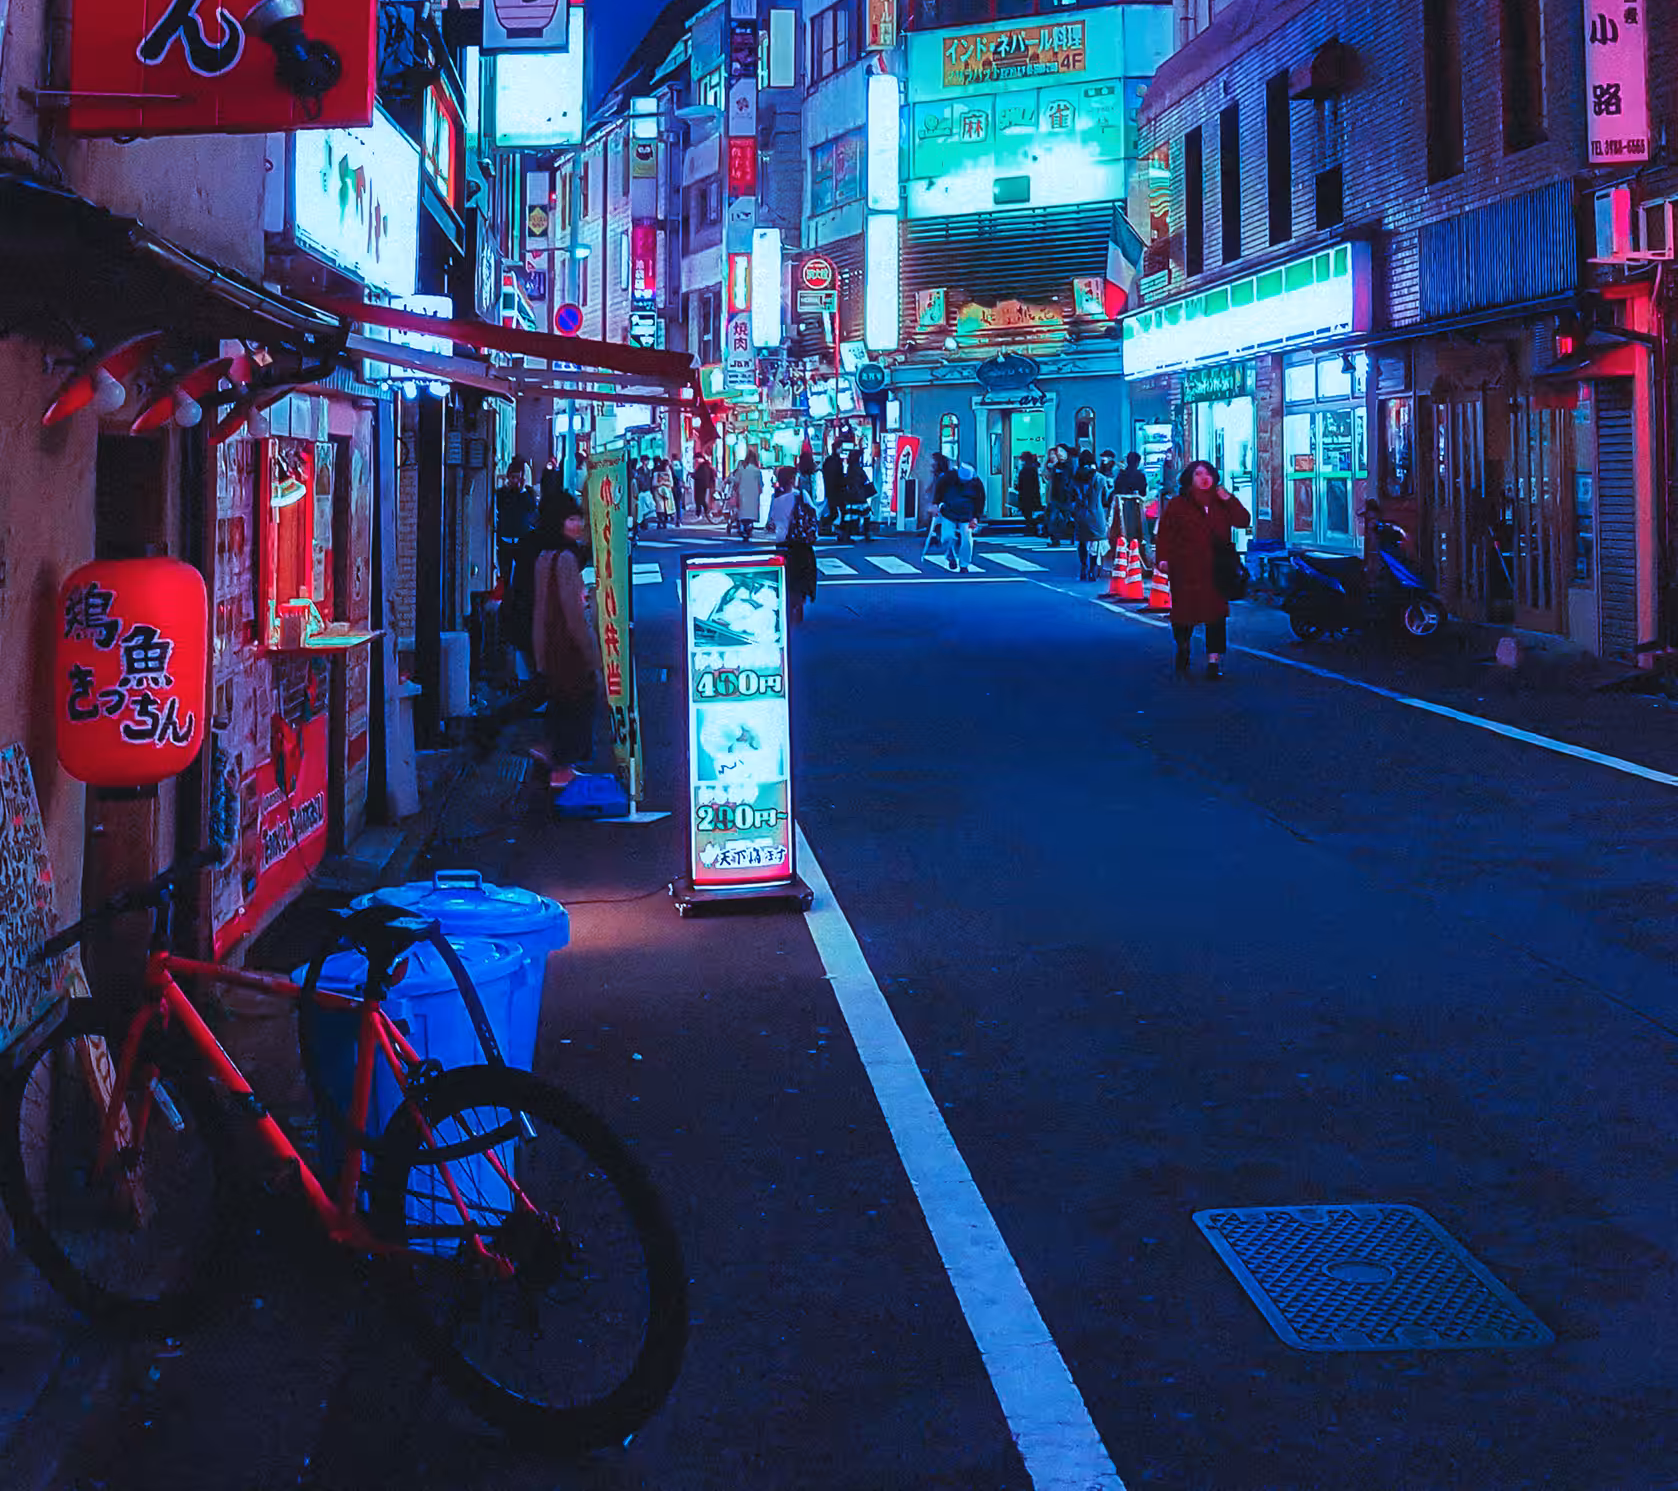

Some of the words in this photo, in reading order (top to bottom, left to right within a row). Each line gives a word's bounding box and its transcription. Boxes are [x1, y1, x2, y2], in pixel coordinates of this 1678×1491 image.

[1060, 52, 1084, 70] 4F
[733, 321, 749, 351] 焼肉
[68, 662, 195, 748] きっちん
